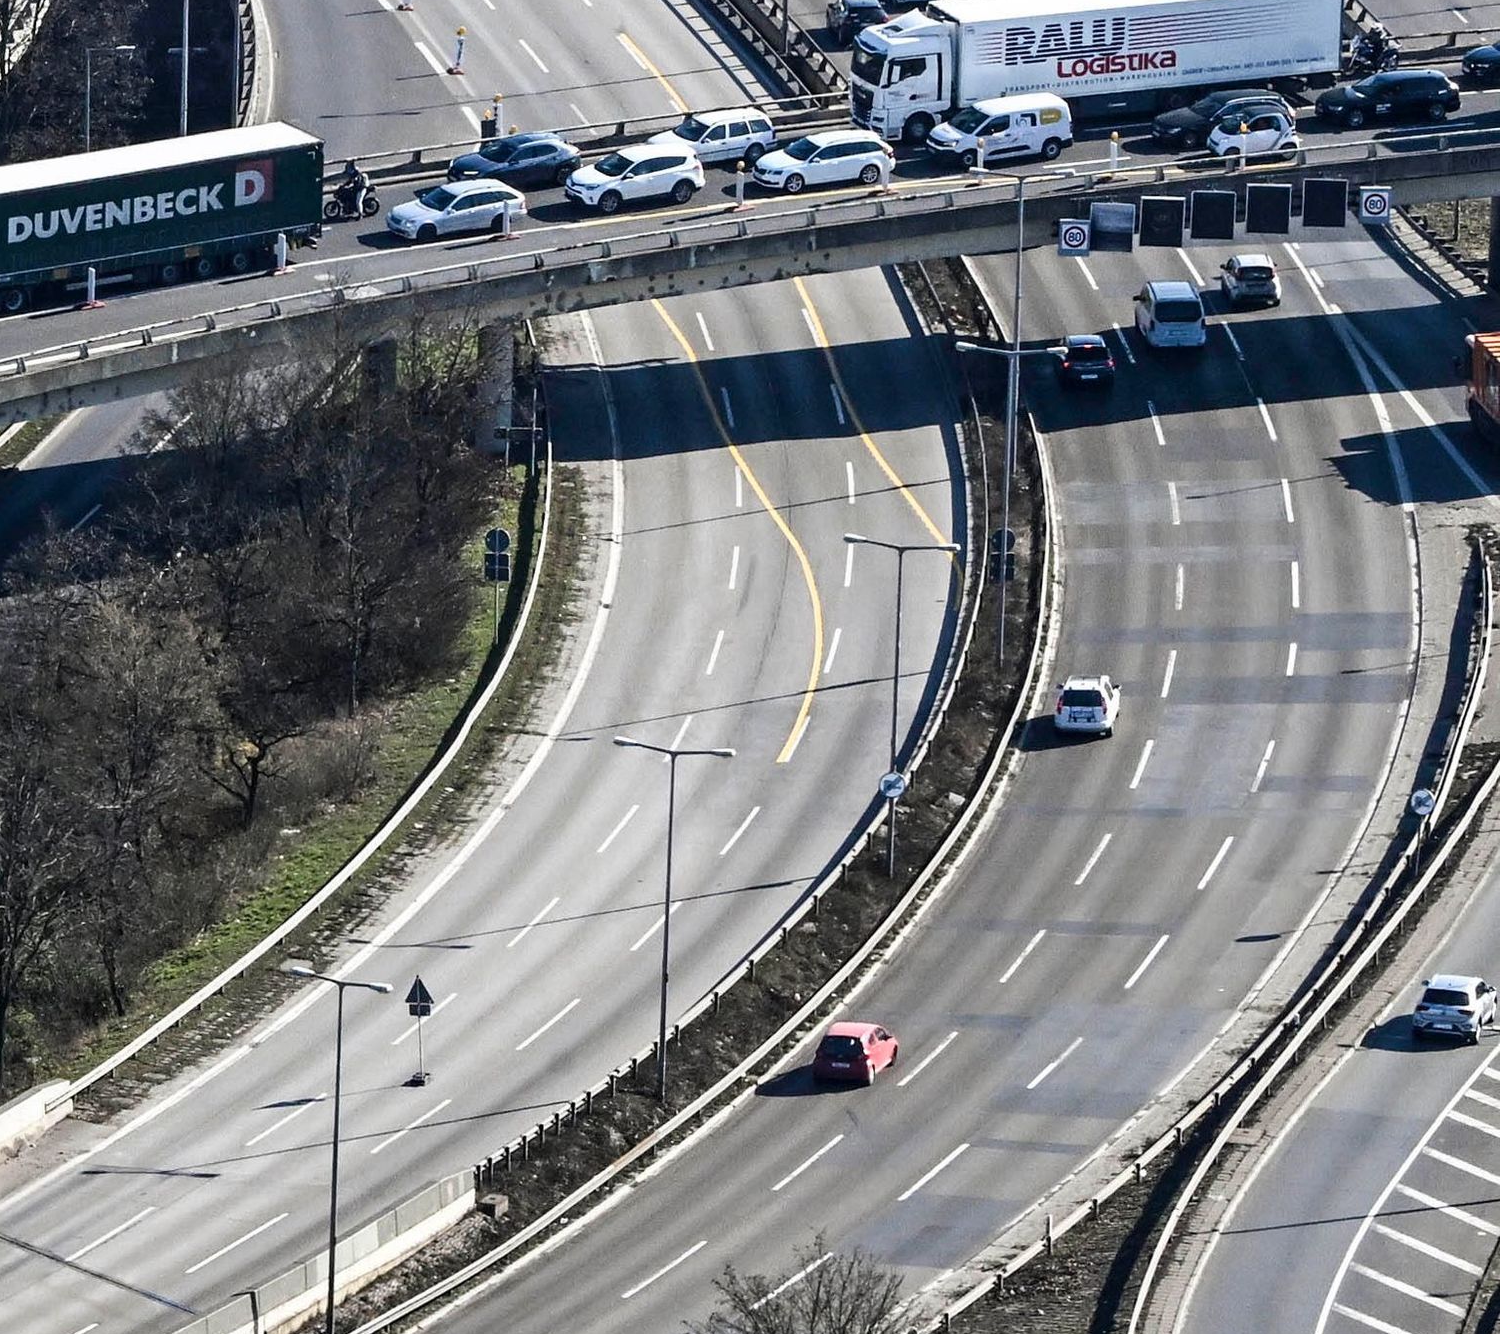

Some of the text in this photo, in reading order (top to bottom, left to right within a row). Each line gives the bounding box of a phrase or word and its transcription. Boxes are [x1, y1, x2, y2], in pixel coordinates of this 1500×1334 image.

[1005, 17, 1126, 66] RALU
[7, 182, 226, 244] DUVENBECK
[1368, 199, 1382, 209] 80
[1068, 232, 1082, 242] 80
